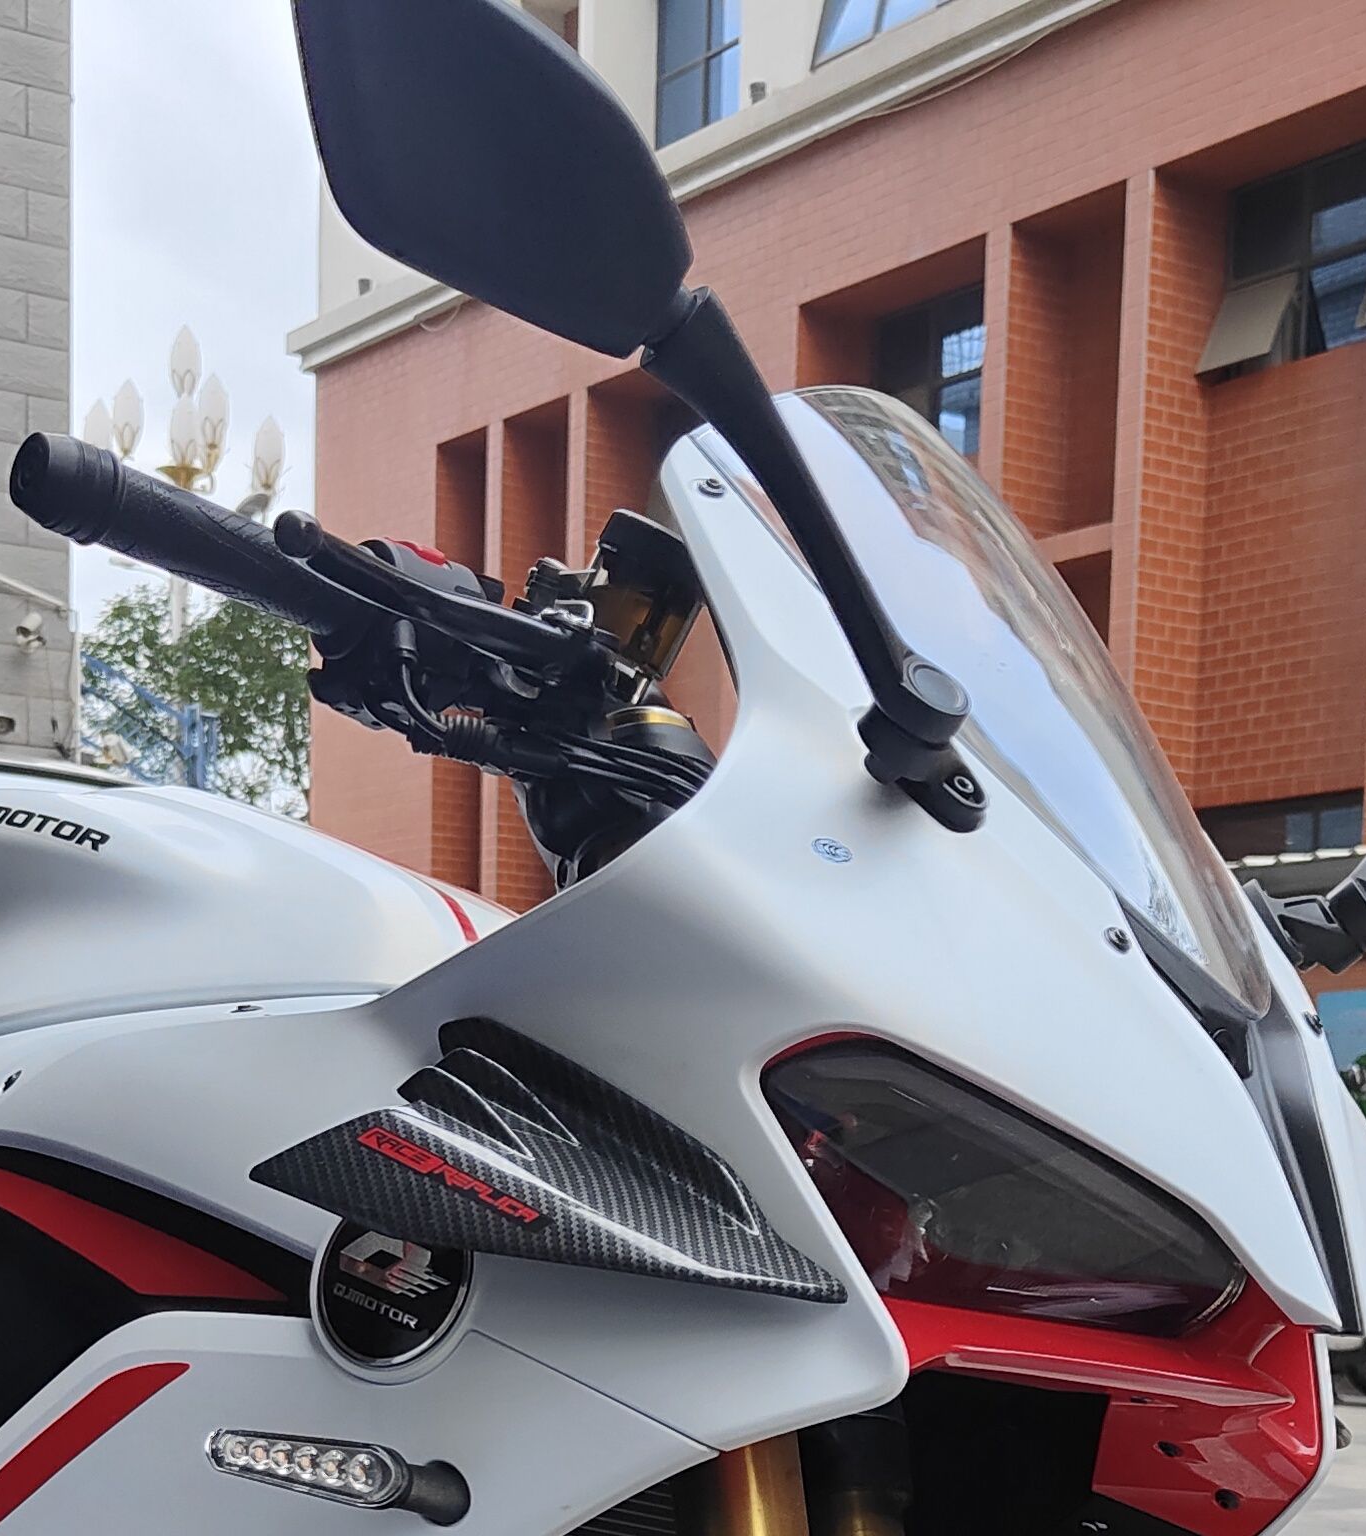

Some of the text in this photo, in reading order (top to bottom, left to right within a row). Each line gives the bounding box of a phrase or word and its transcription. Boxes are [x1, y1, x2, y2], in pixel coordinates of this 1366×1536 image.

[365, 1131, 541, 1224] RACE REPLICA
[332, 1281, 419, 1330] QJMOTOR
